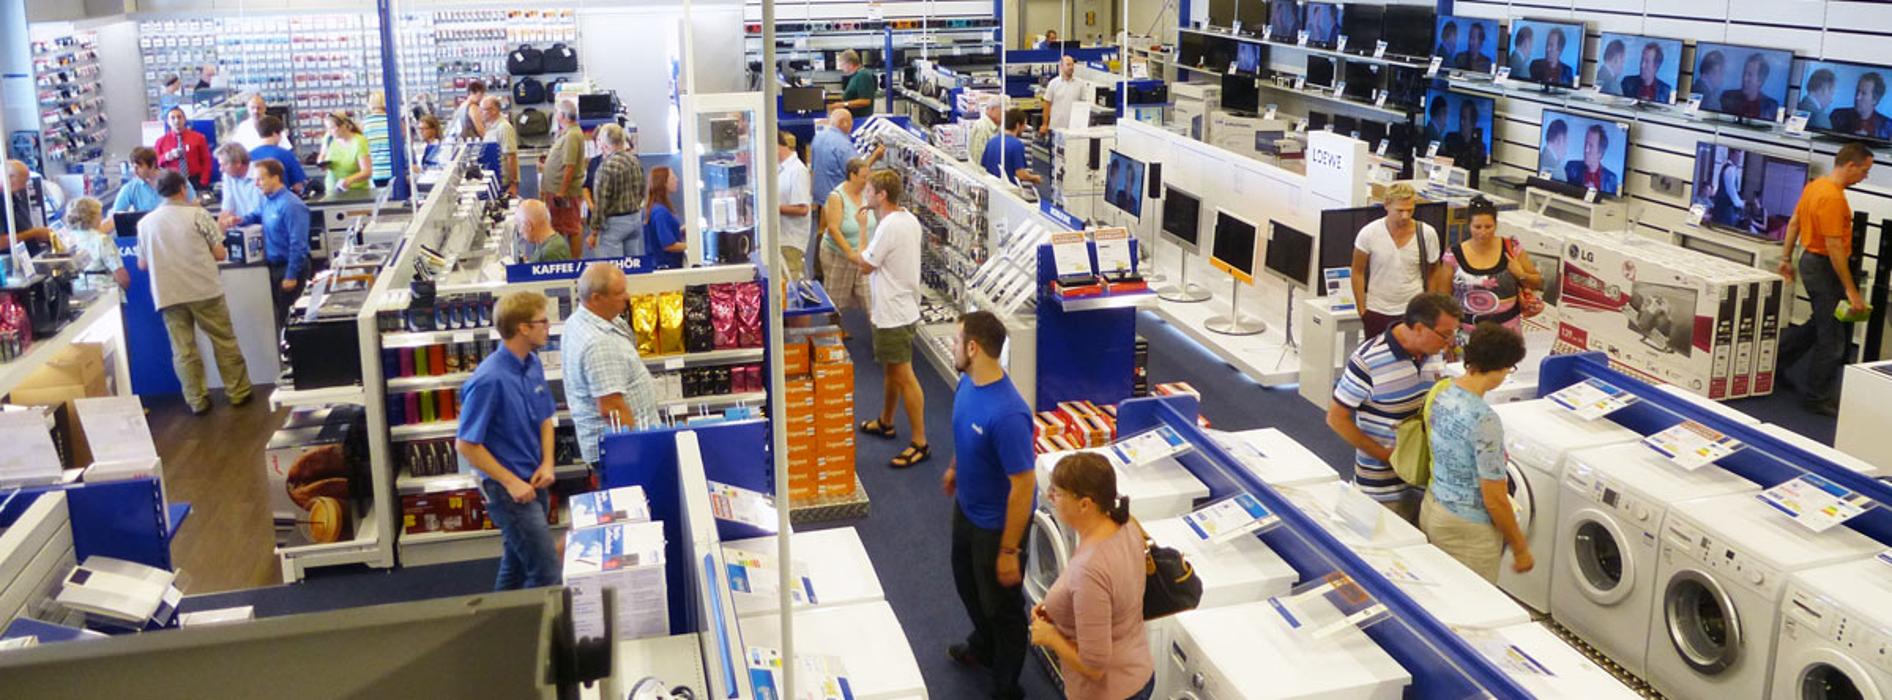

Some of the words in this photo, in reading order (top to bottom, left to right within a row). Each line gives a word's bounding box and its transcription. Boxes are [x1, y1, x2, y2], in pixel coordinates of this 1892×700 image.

[1312, 148, 1342, 169] LOEWE
[1581, 250, 1594, 262] LG
[532, 262, 574, 275] KAFFEE
